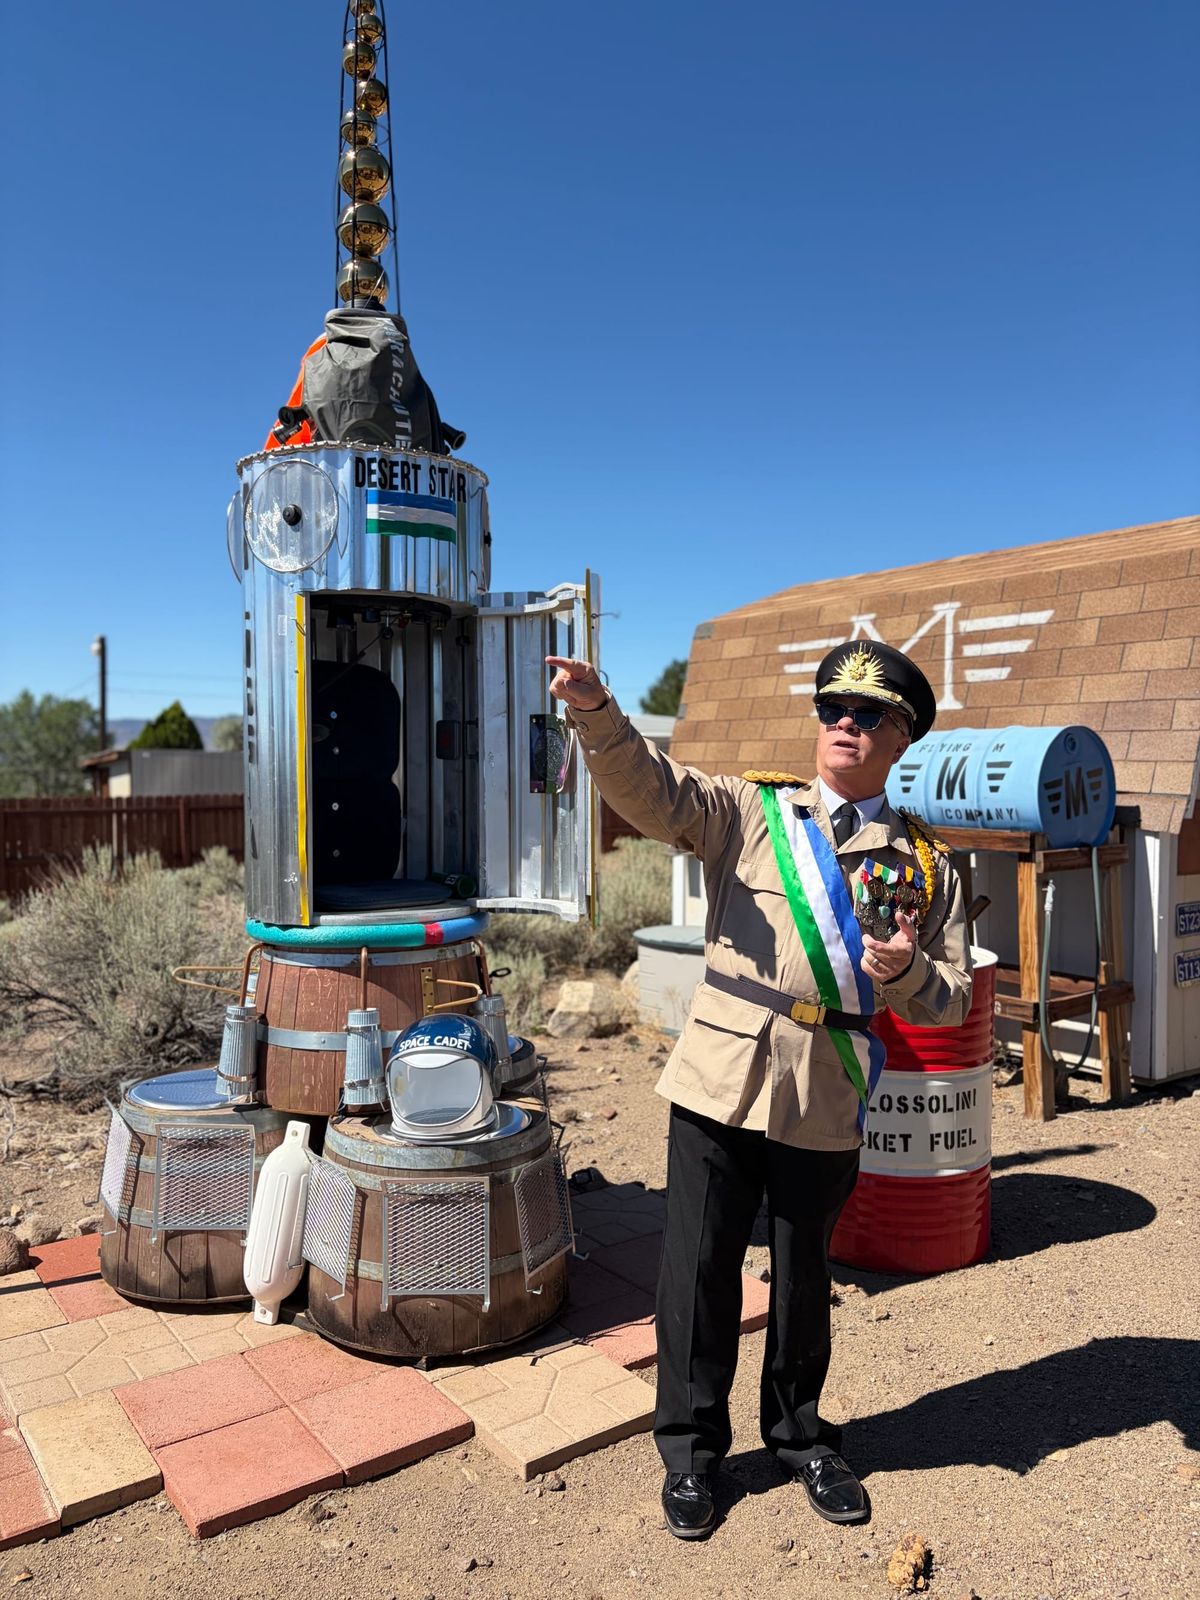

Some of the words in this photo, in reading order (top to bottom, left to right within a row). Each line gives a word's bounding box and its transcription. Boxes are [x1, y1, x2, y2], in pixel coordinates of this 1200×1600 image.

[355, 456, 422, 494] DESERT
[429, 464, 467, 503] STAR
[919, 742, 972, 753] FLYING
[992, 743, 1005, 753] M
[936, 755, 969, 800] M
[1064, 767, 1088, 820] M
[945, 807, 1015, 821] COMPANY
[398, 1035, 431, 1052] SPACE
[433, 1035, 470, 1051] CADET
[865, 1131, 912, 1153] KET
[930, 1127, 977, 1152] FUEL
